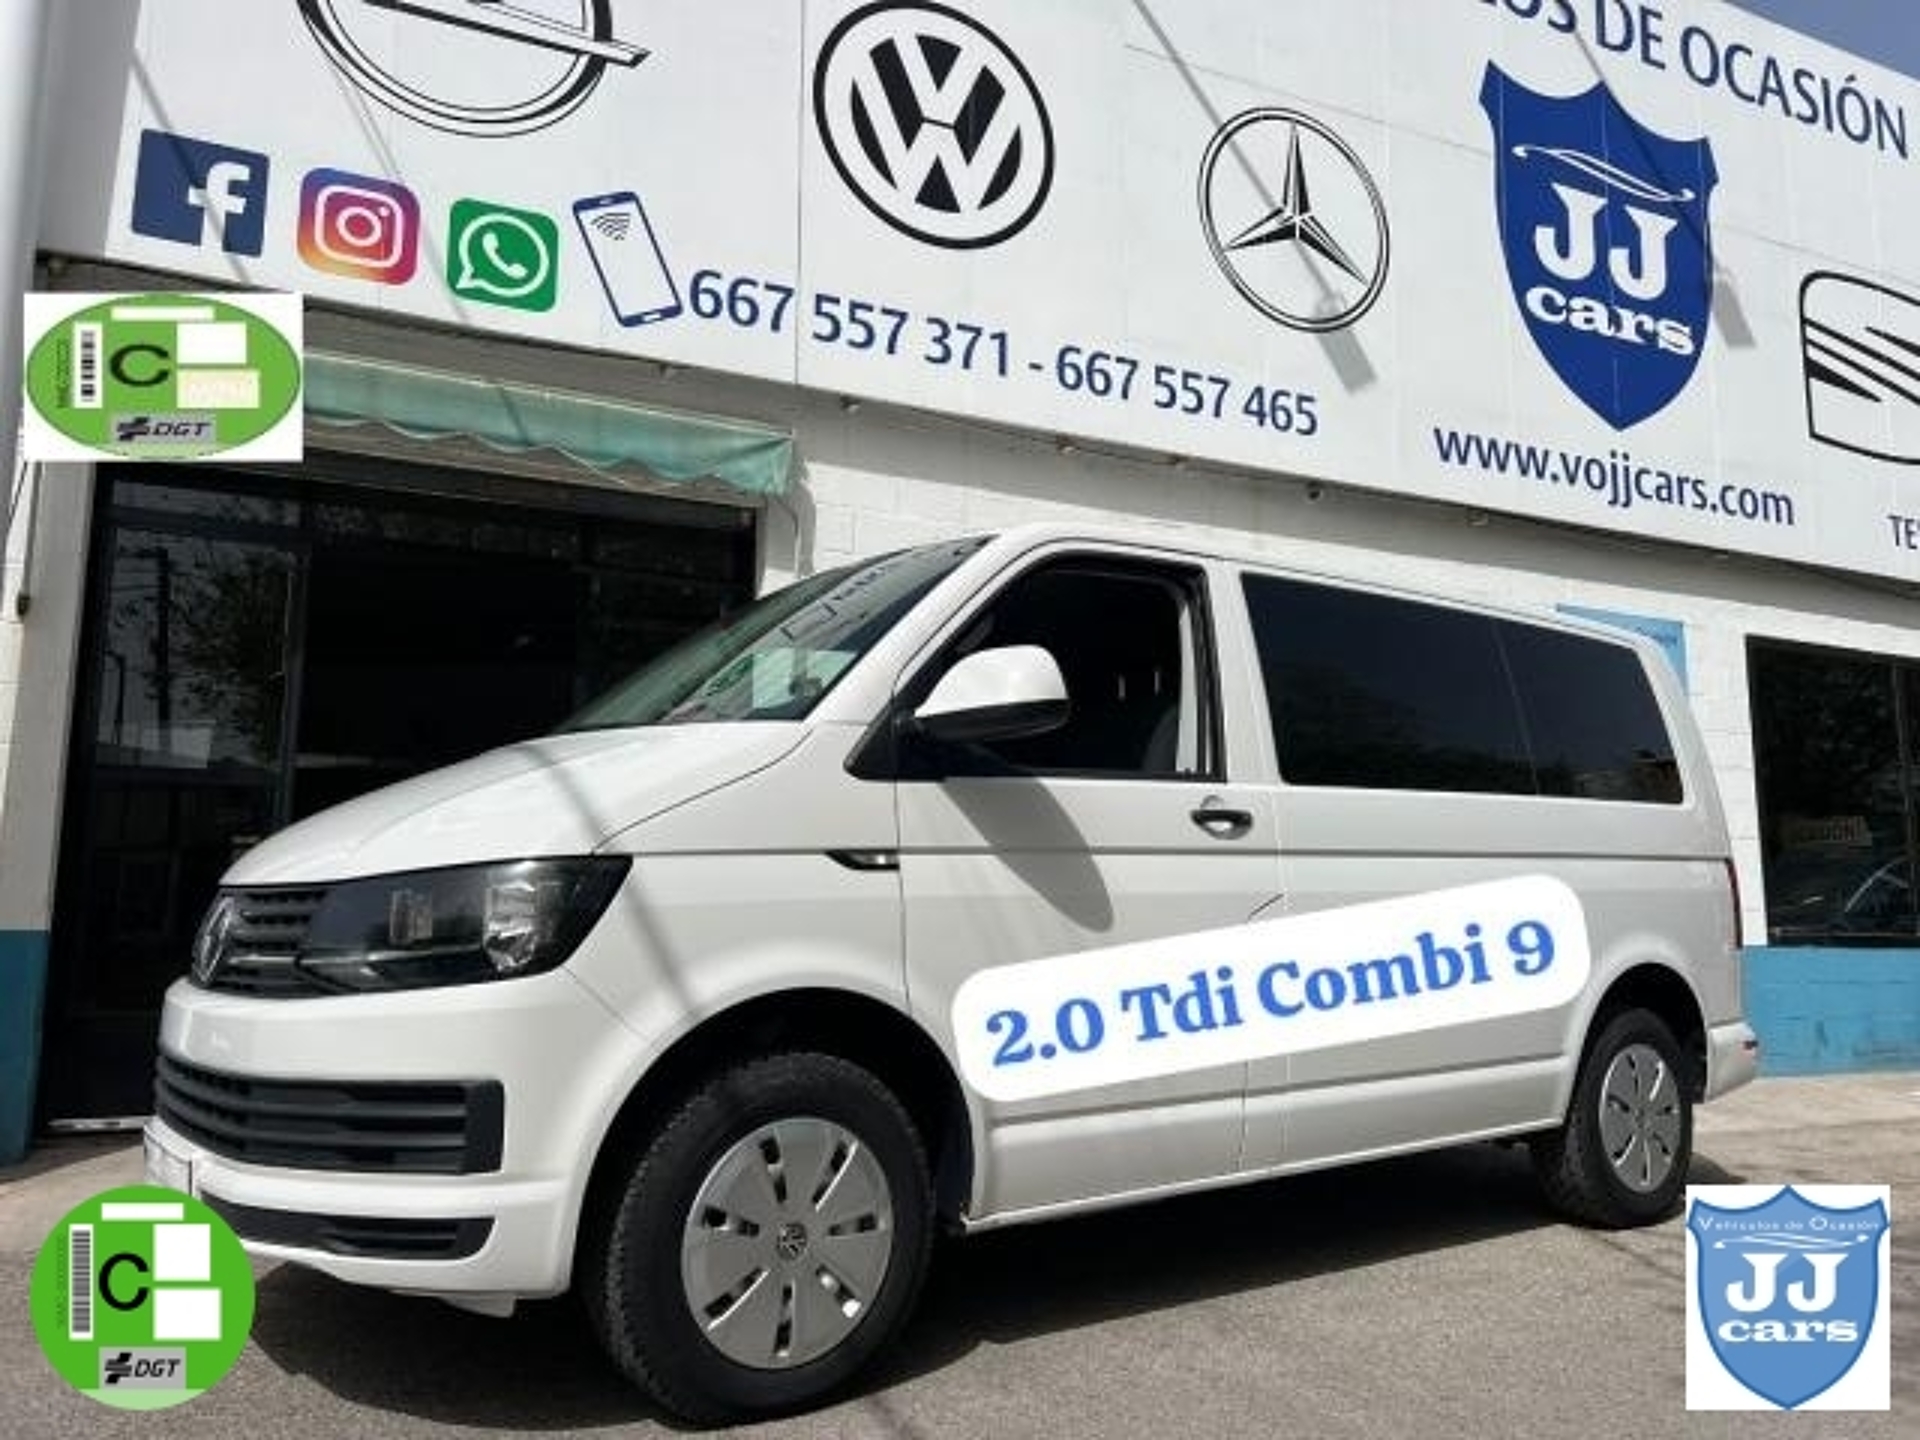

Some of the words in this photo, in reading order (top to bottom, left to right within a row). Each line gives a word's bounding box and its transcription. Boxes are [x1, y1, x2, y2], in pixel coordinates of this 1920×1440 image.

[1594, 0, 1667, 71] DE
[1679, 25, 1909, 160] OCASIÓN
[1534, 182, 1678, 300] JJ
[689, 269, 795, 333] 667
[812, 292, 909, 356] 557
[924, 316, 1008, 378] 371
[1055, 345, 1139, 401] 667
[1153, 364, 1231, 419] 557
[1242, 385, 1318, 436] 465
[1525, 286, 1695, 357] cars
[1433, 426, 1795, 526] www.vojjcars.com
[1886, 514, 1920, 552] TE
